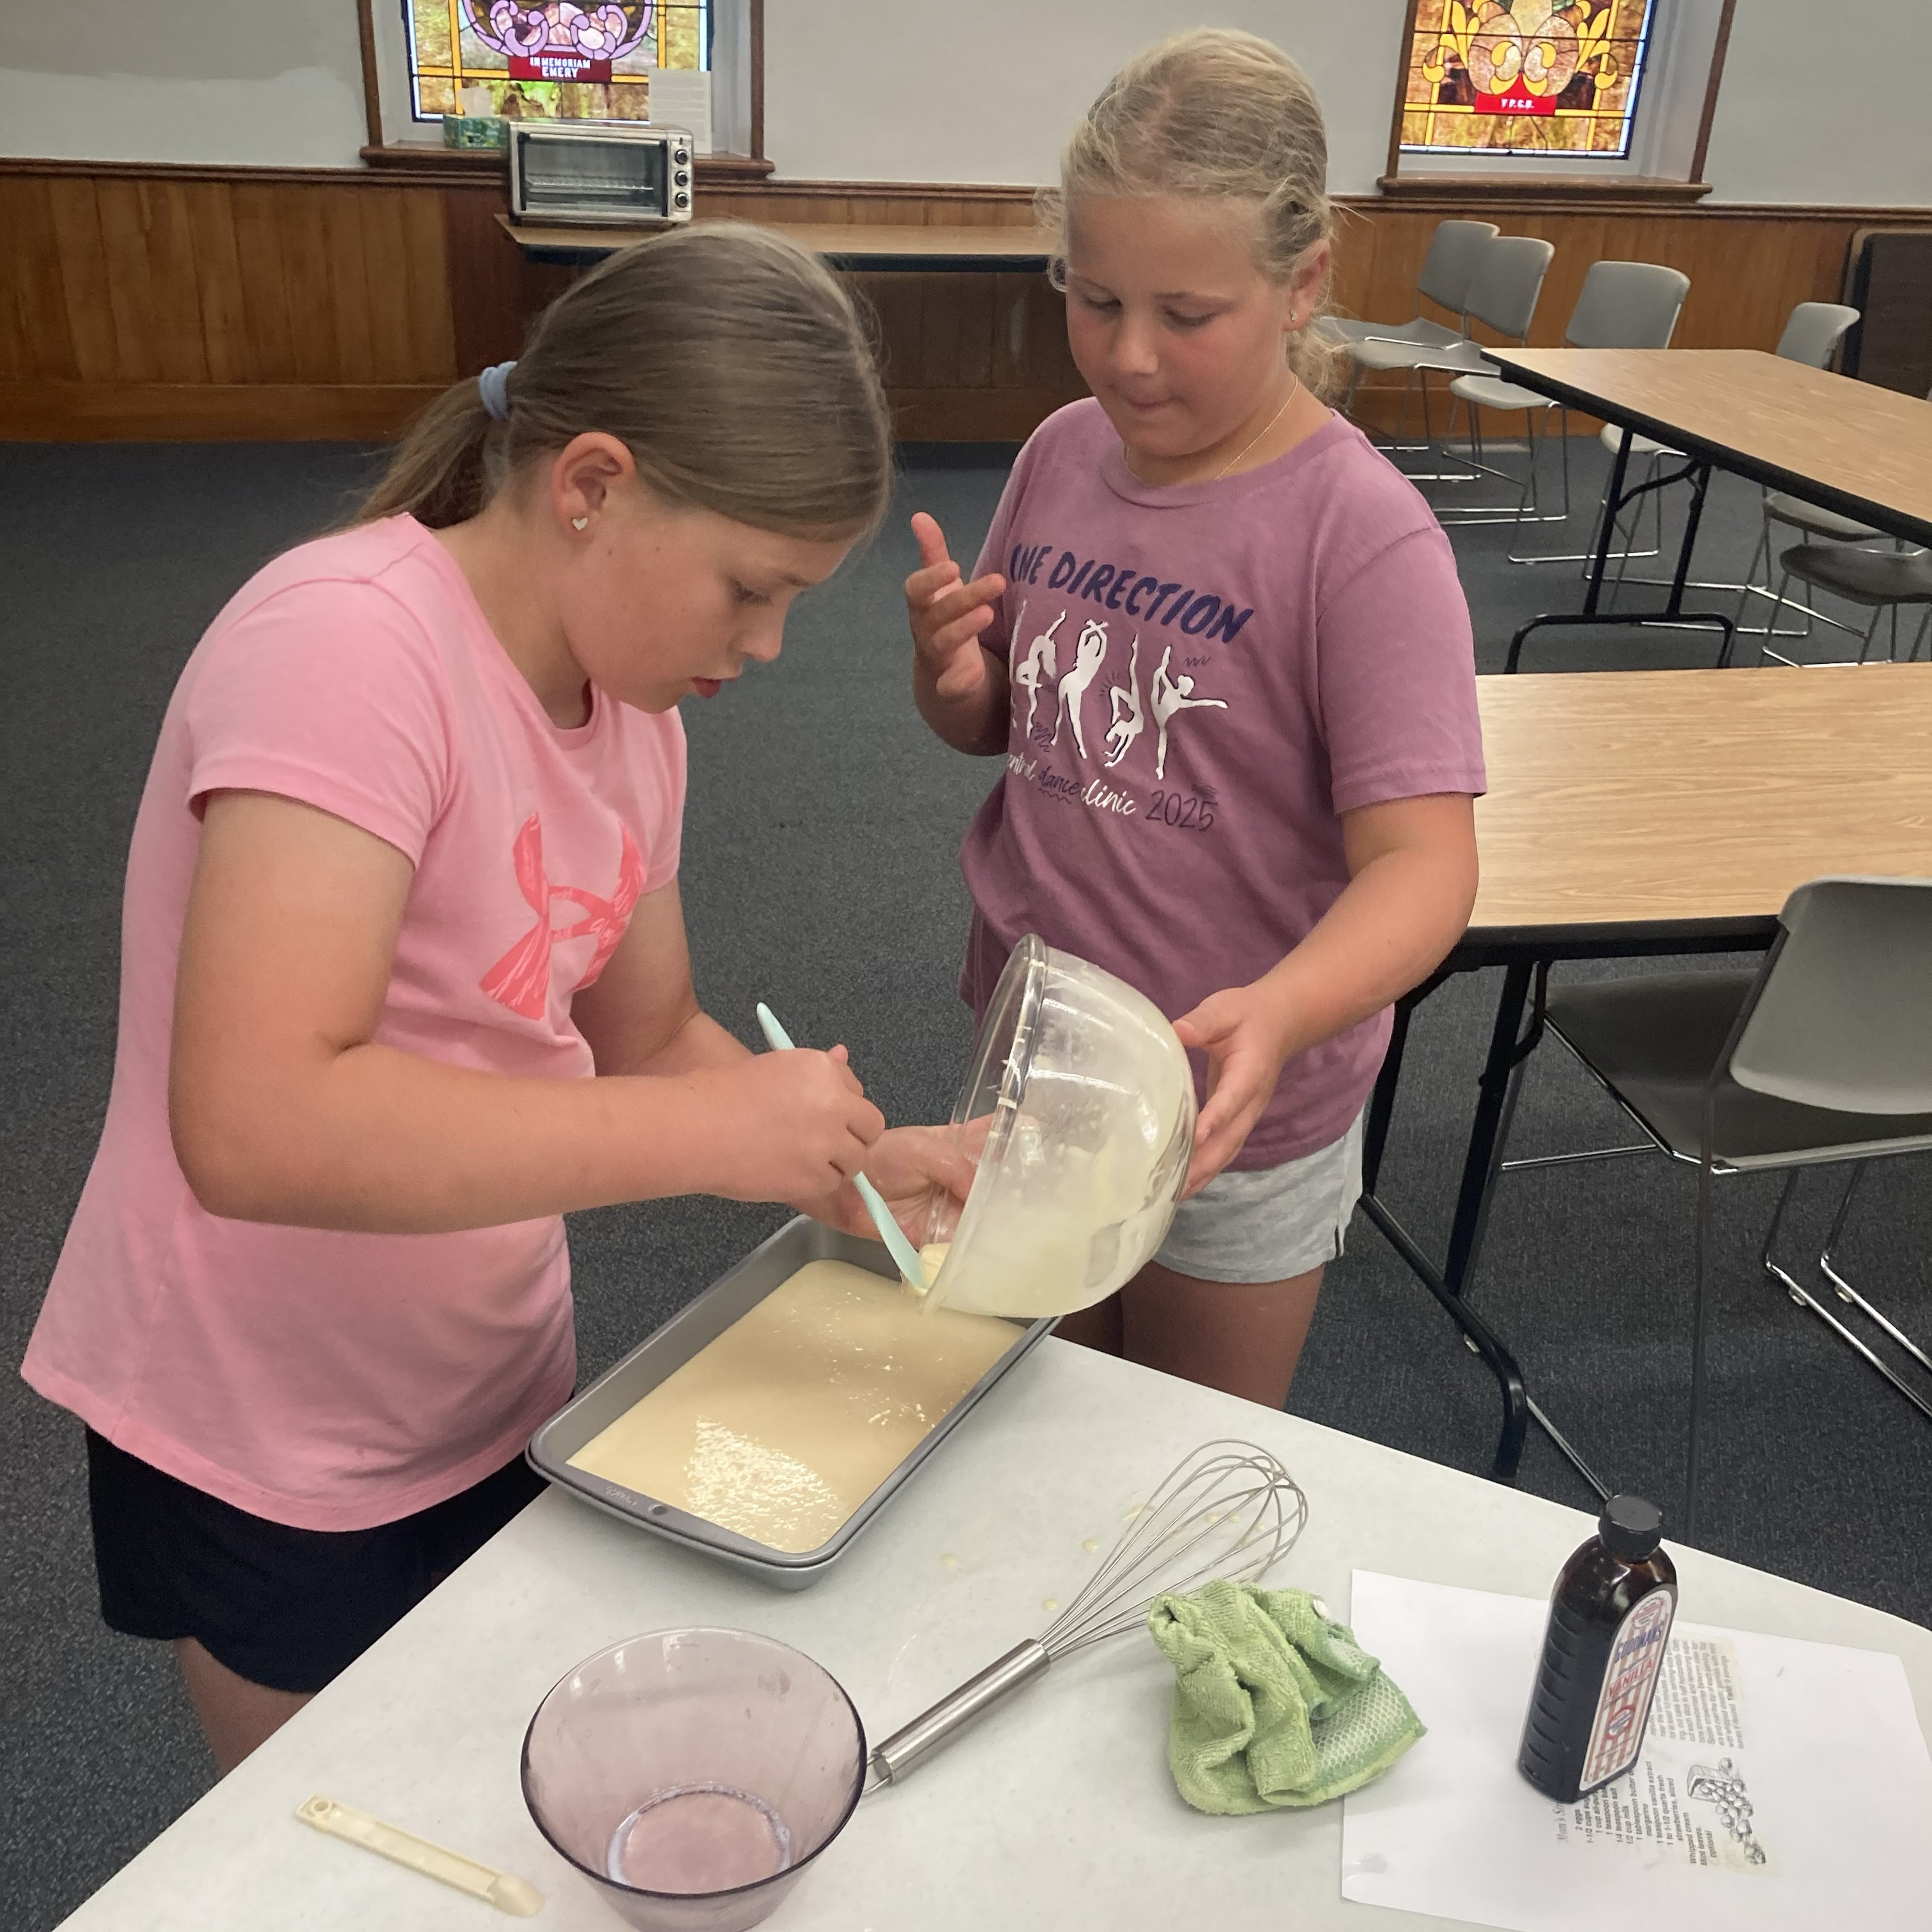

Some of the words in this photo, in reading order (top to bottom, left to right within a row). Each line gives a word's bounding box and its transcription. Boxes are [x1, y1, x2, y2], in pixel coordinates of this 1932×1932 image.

[542, 66, 578, 78] EMERY
[1048, 551, 1255, 644] DIRECTION
[1038, 765, 1080, 795] dance
[1146, 790, 1218, 832] 2025
[1609, 1659, 1653, 1696] VANILLA
[1645, 1761, 1654, 1783] extract
[1629, 1777, 1637, 1797] butter
[1649, 1785, 1658, 1805] vanilla
[1667, 1778, 1676, 1797] sliced
[1603, 1800, 1611, 1829] teaspoon
[1613, 1801, 1622, 1831] teaspoon
[1621, 1805, 1630, 1819] milk
[1632, 1798, 1642, 1834] tablespoon
[1660, 1793, 1669, 1814] quarts
[1575, 1809, 1583, 1825] eggs
[1643, 1804, 1652, 1836] margarine
[1653, 1807, 1662, 1838] teaspoon
[1662, 1816, 1671, 1830] 1-1/2
[1672, 1799, 1683, 1841] strawberries,
[1683, 1813, 1692, 1832] cream
[1615, 1834, 1623, 1843] 1/4
[1687, 1834, 1697, 1864] Whipped
[1705, 1830, 1717, 1858] optional
